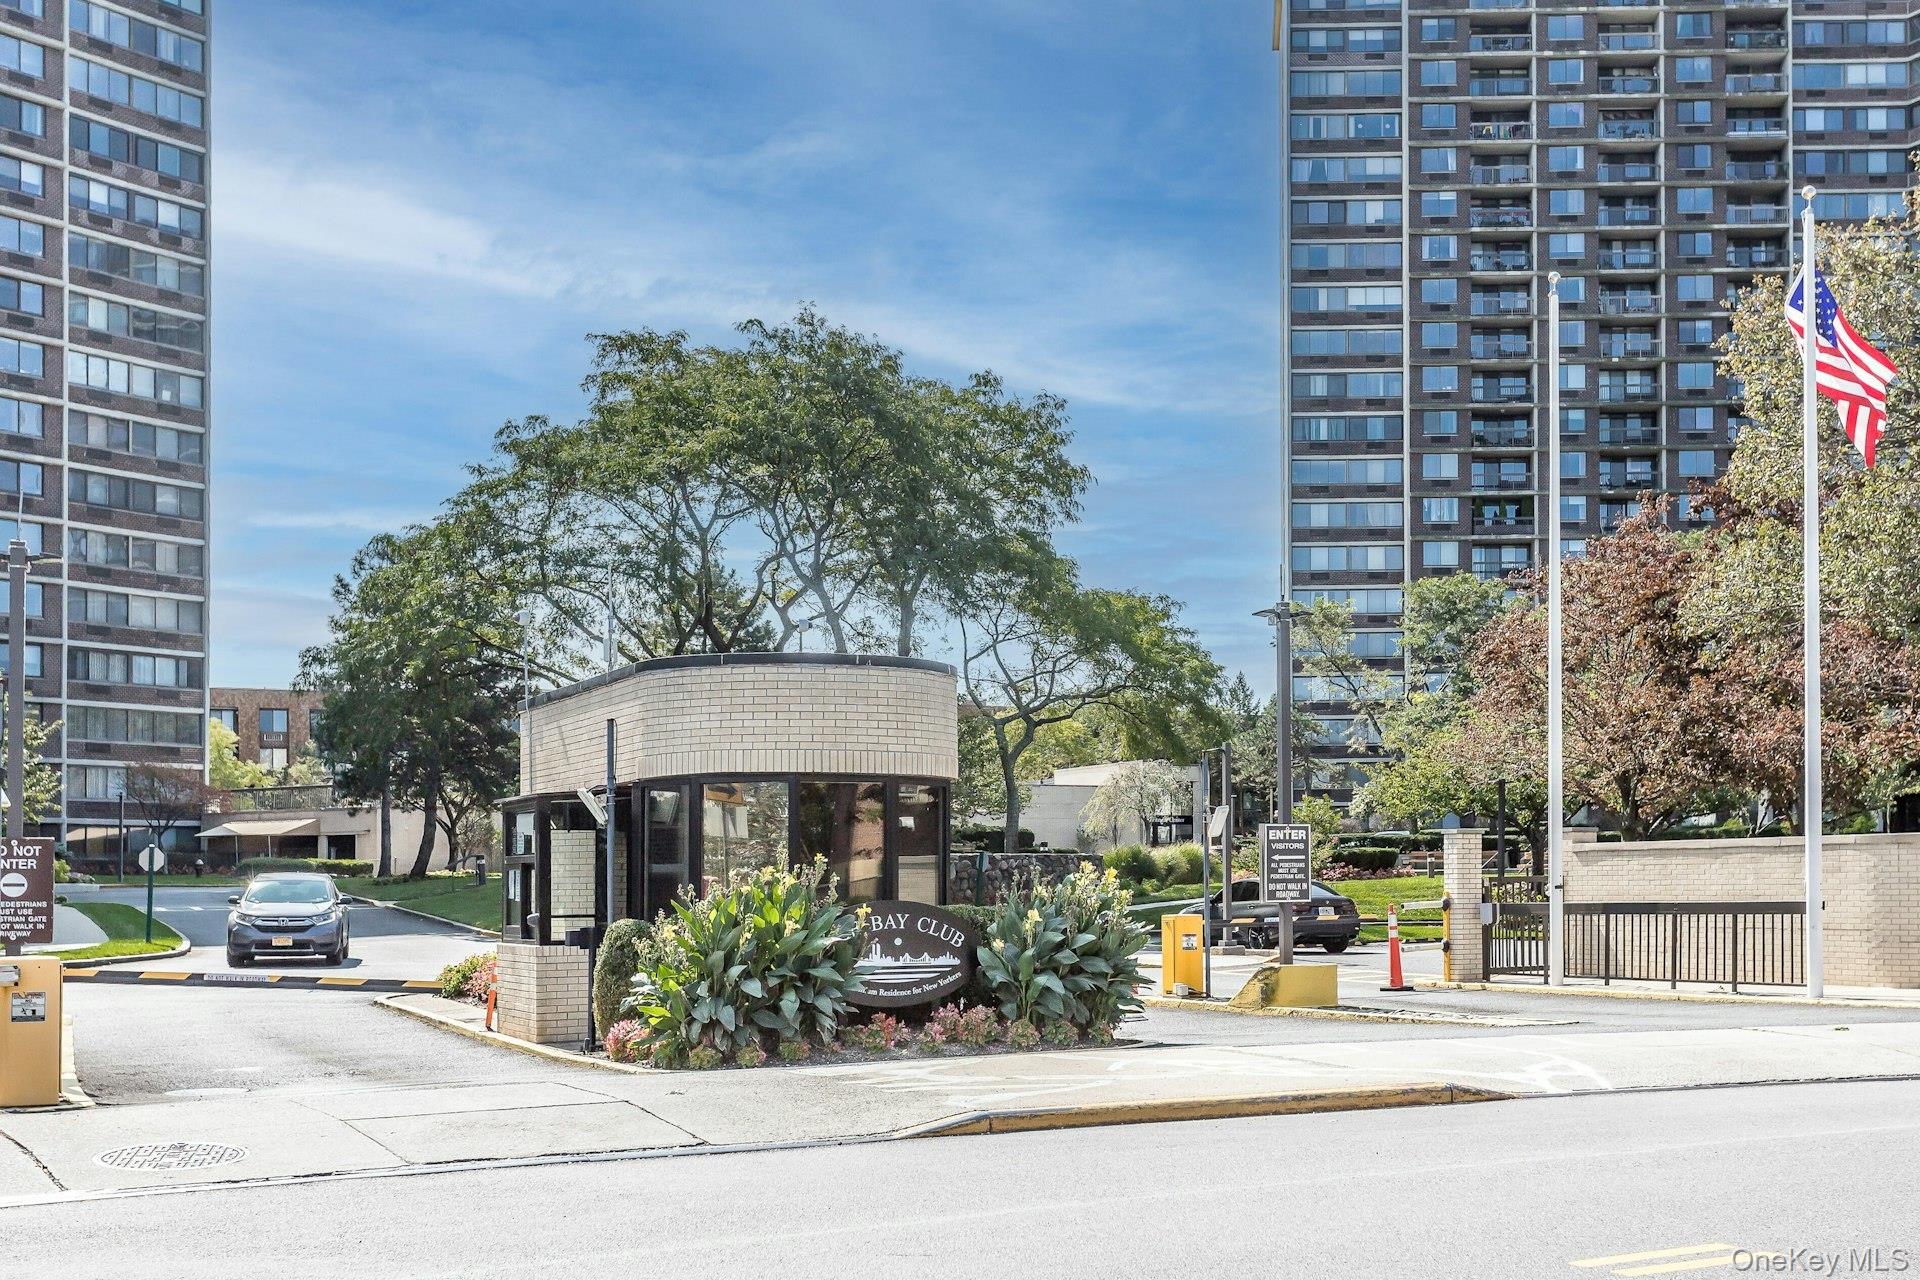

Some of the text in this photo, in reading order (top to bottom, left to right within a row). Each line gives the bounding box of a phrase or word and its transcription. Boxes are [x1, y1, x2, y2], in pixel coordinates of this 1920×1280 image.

[1269, 830, 1306, 840] ENTER
[0, 845, 42, 857] O NOT
[0, 859, 37, 870] NTER
[869, 913, 910, 932] BAY
[917, 916, 965, 948] CLUB
[879, 988, 912, 997] Residence
[912, 986, 922, 995] for
[922, 984, 938, 992] New
[938, 971, 962, 987] Yorkers
